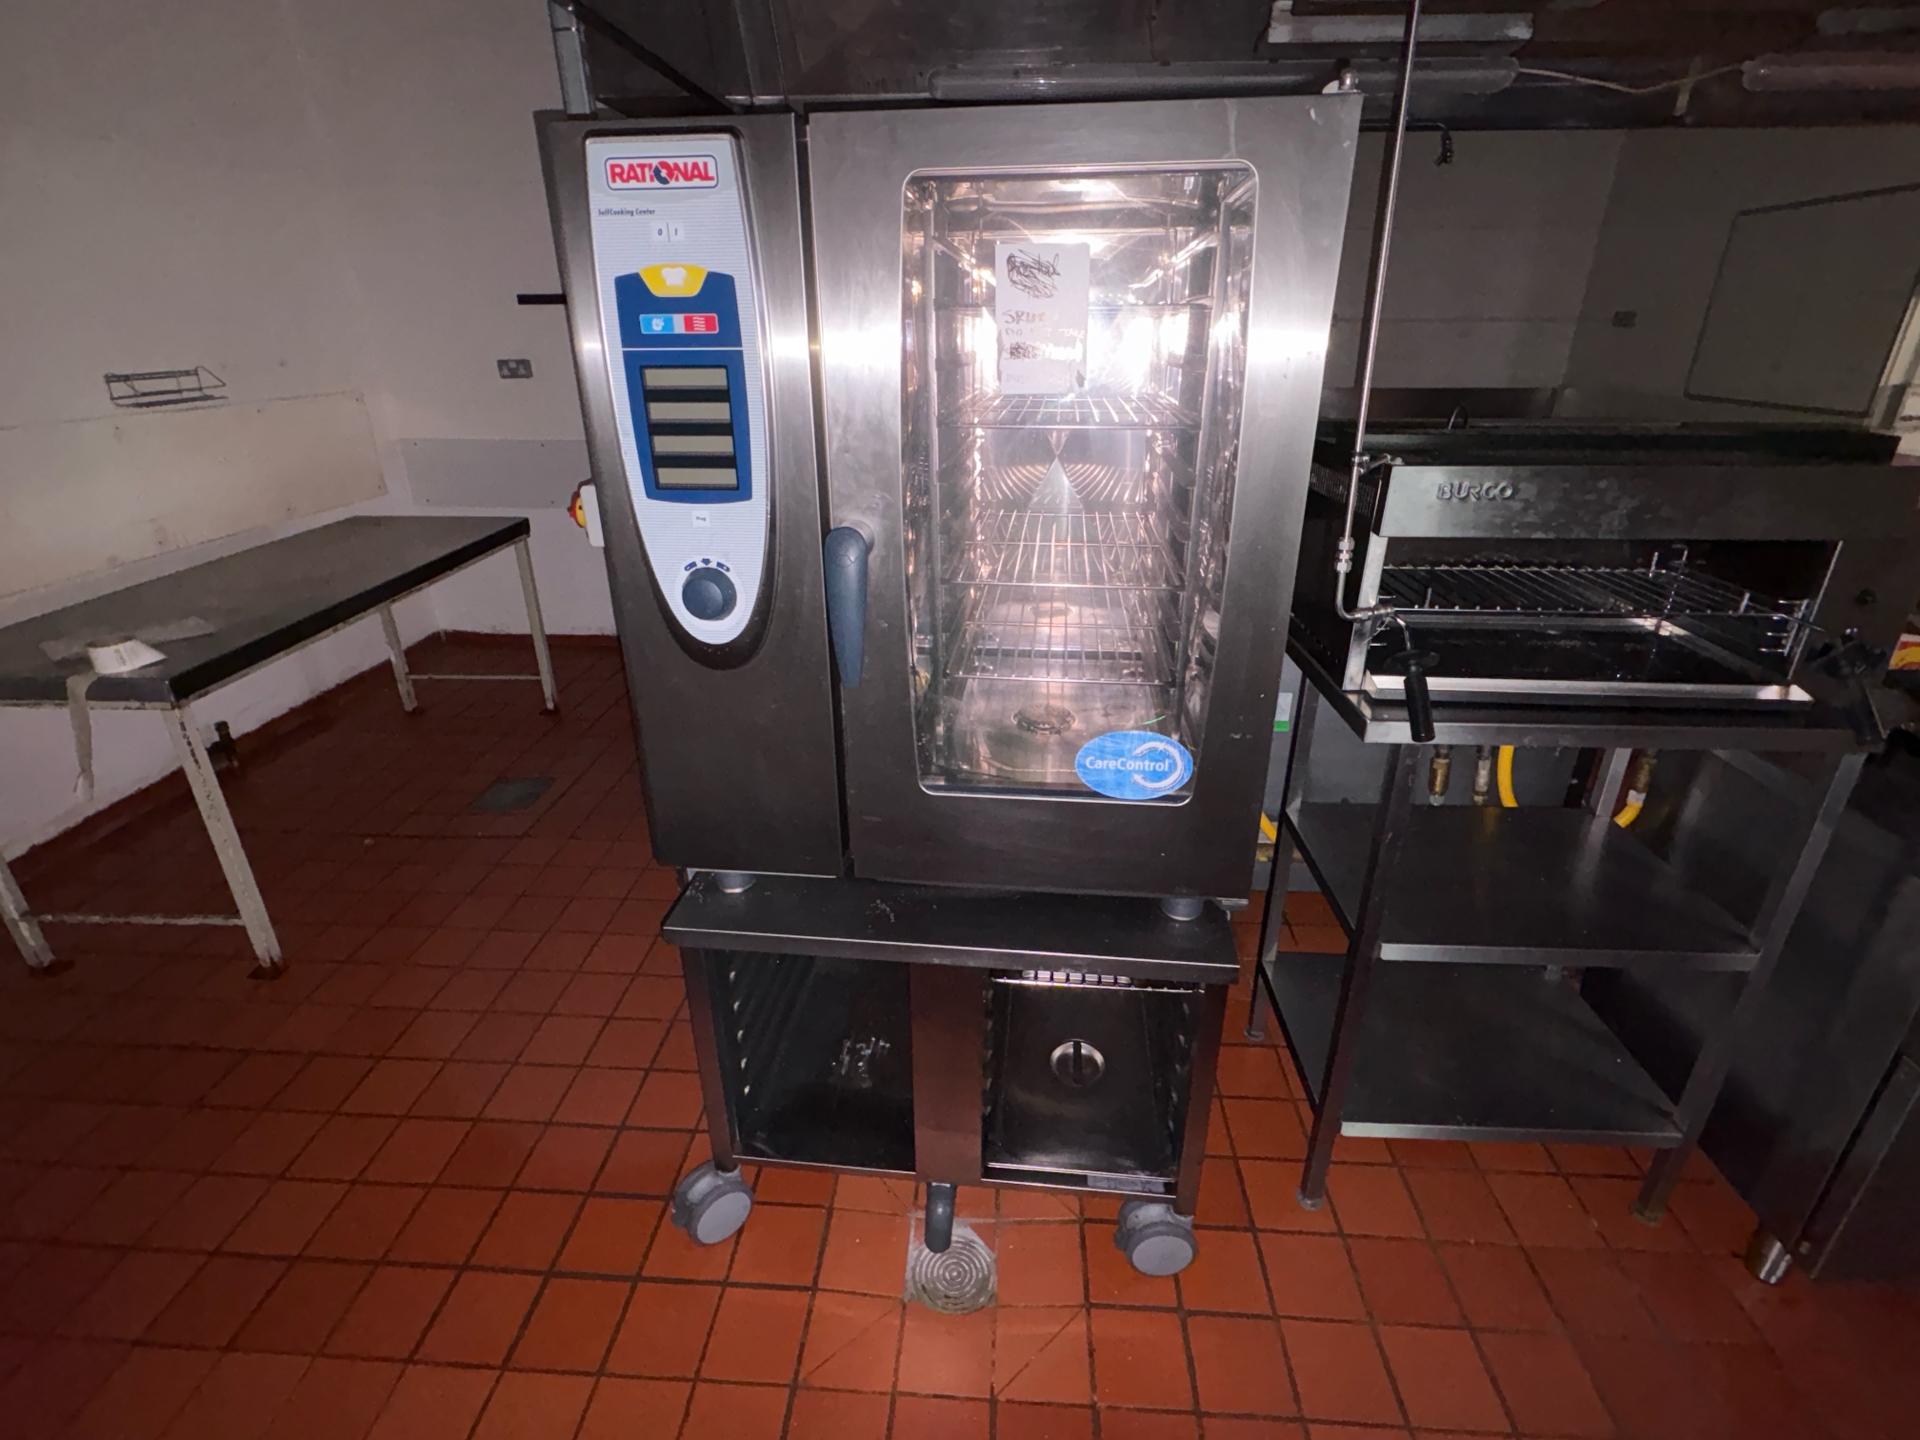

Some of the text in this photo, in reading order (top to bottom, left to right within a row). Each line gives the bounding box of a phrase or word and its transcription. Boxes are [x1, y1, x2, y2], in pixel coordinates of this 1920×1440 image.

[608, 160, 715, 185] RATIONAL
[635, 208, 656, 216] Center
[1437, 481, 1513, 501] BURCO
[1085, 756, 1169, 771] CareControl
